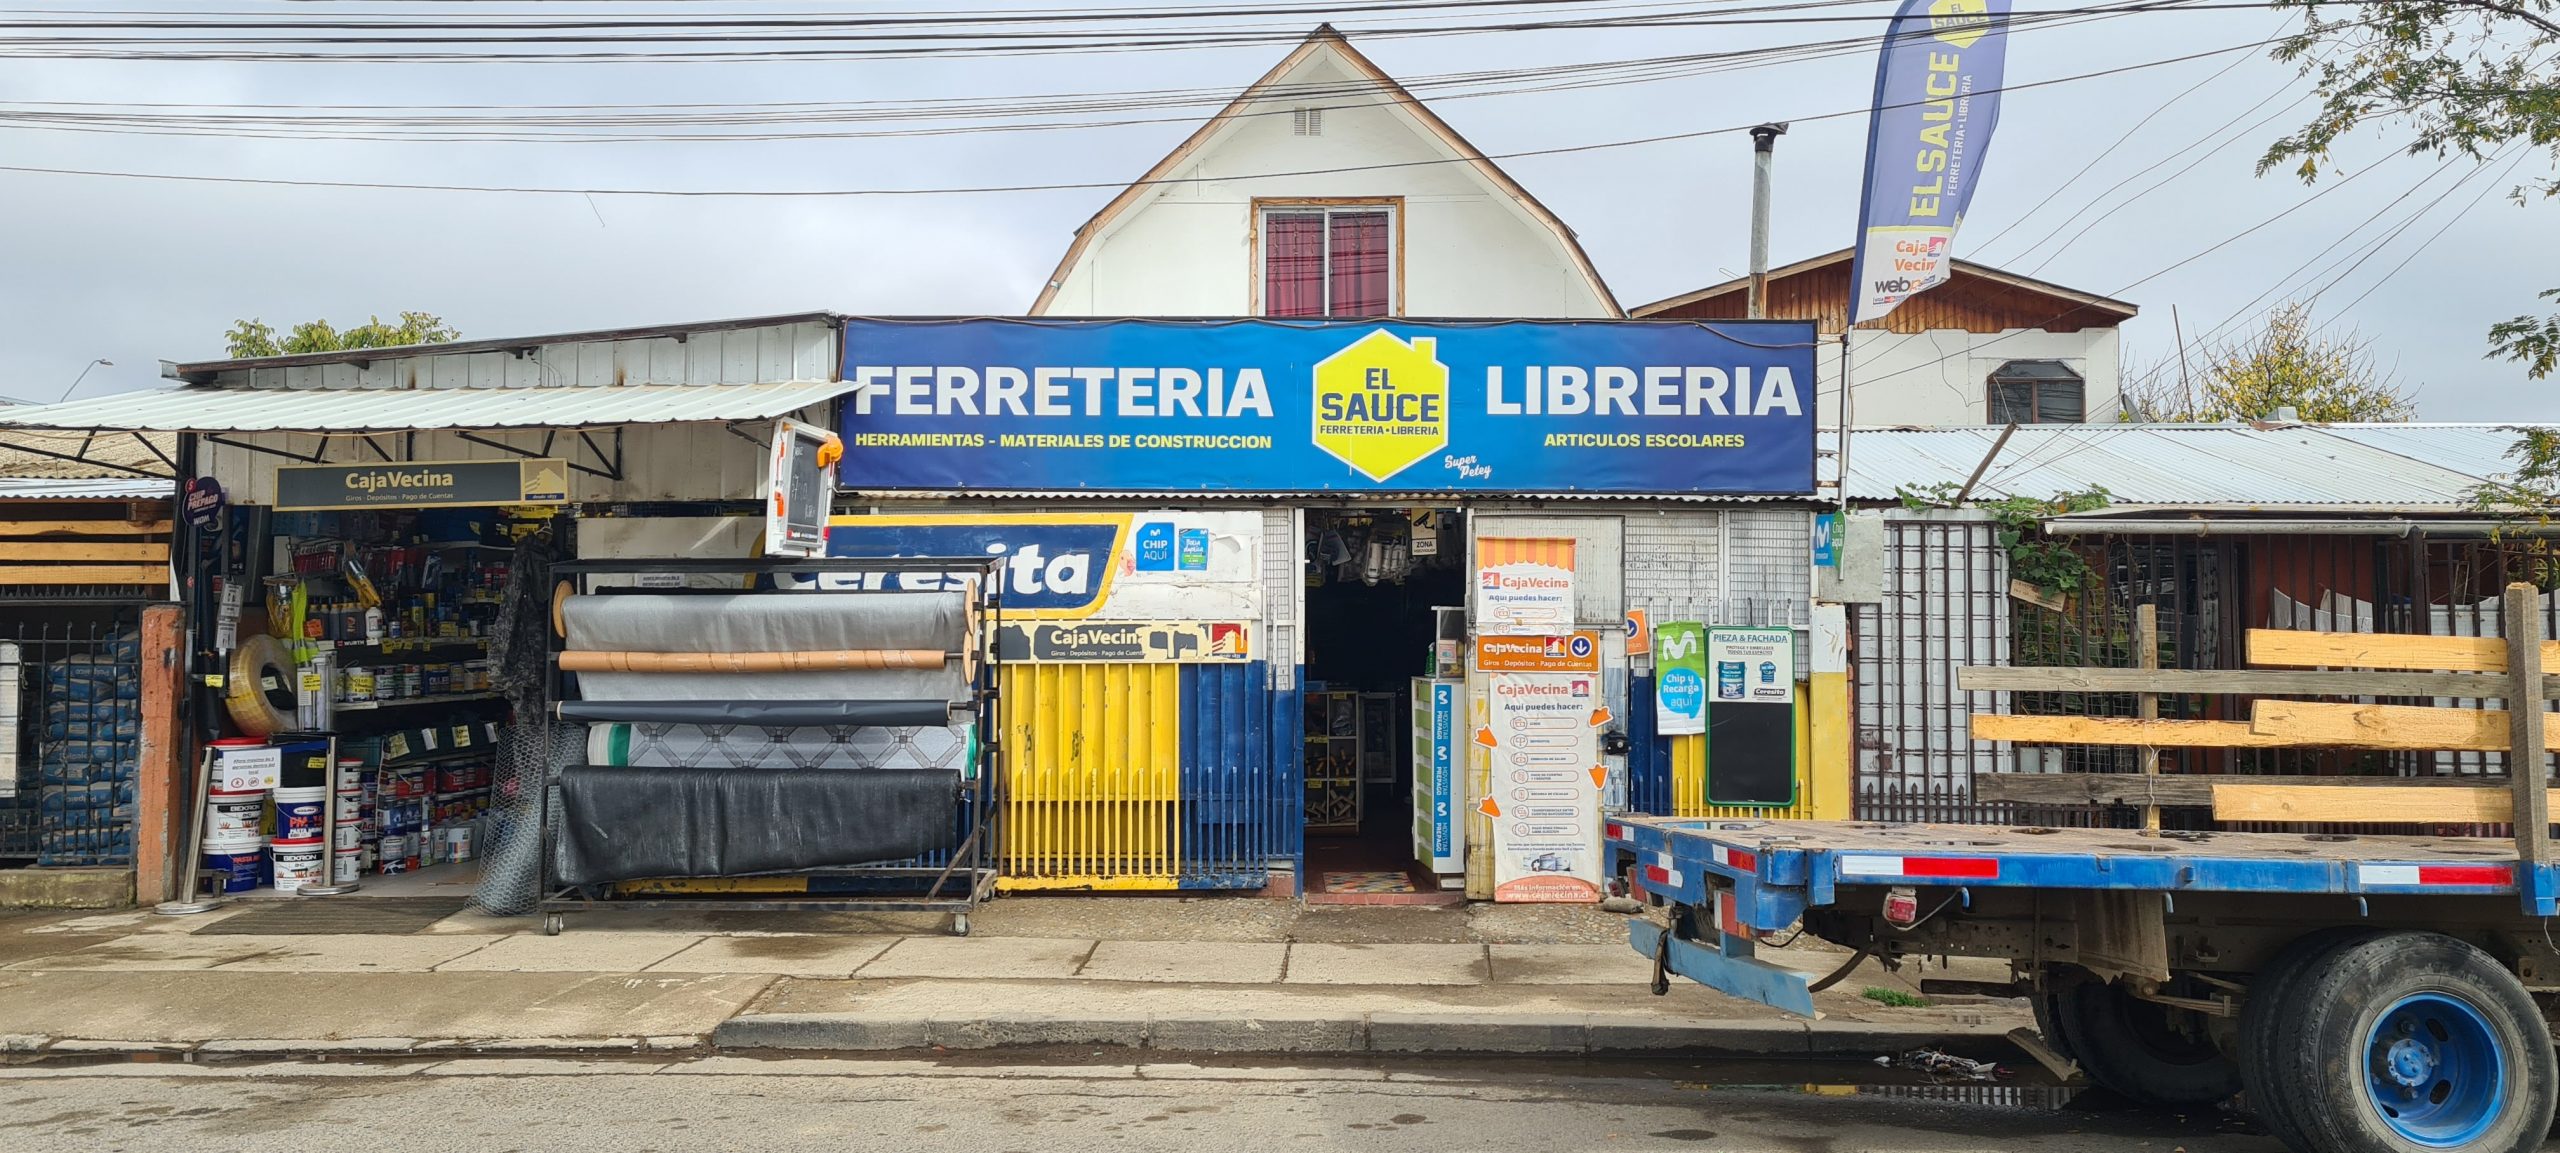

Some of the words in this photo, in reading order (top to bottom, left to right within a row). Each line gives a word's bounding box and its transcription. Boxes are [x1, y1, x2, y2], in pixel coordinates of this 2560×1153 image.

[1951, 3, 1965, 13] EL
[1916, 52, 1960, 172] SAUCE
[1909, 176, 1943, 217] EL
[1896, 240, 1927, 256] Caja
[1895, 258, 1937, 272] Vecin
[1366, 368, 1395, 390] EL
[855, 366, 1274, 418] FERRETERIA
[1487, 366, 1803, 417] LIBRERIA
[1321, 393, 1440, 422] SAUCE
[1320, 425, 1384, 435] FERRETERIA
[1391, 426, 1439, 436] LIBRERIA
[855, 433, 985, 448] HERRAMIENTAS
[1000, 434, 1104, 449] MATERIALES
[1109, 435, 1131, 449] DE
[1135, 435, 1272, 449] CONSTRUCCION
[1545, 433, 1641, 448] ARTICULOS
[1646, 434, 1745, 448] ESCOLARES
[1444, 455, 1477, 469] Super
[1459, 464, 1492, 480] Petey
[345, 469, 453, 493] CajaVecina
[1143, 540, 1168, 549] CHIP
[1143, 548, 1168, 560] AQUÍ
[1502, 577, 1569, 590] CajaVecina
[1713, 634, 1738, 642] PIEZA
[1740, 634, 1746, 642] &
[1747, 634, 1787, 643] FACHADA
[1483, 643, 1542, 655] CajaVecina
[1540, 660, 1556, 668] Pago
[1567, 660, 1592, 668] Cuentas
[1666, 674, 1686, 684] Chip
[1688, 675, 1695, 684] y
[1497, 684, 1568, 697] CajaVecina
[1663, 685, 1699, 695] Recarga
[1525, 704, 1556, 712] puedes
